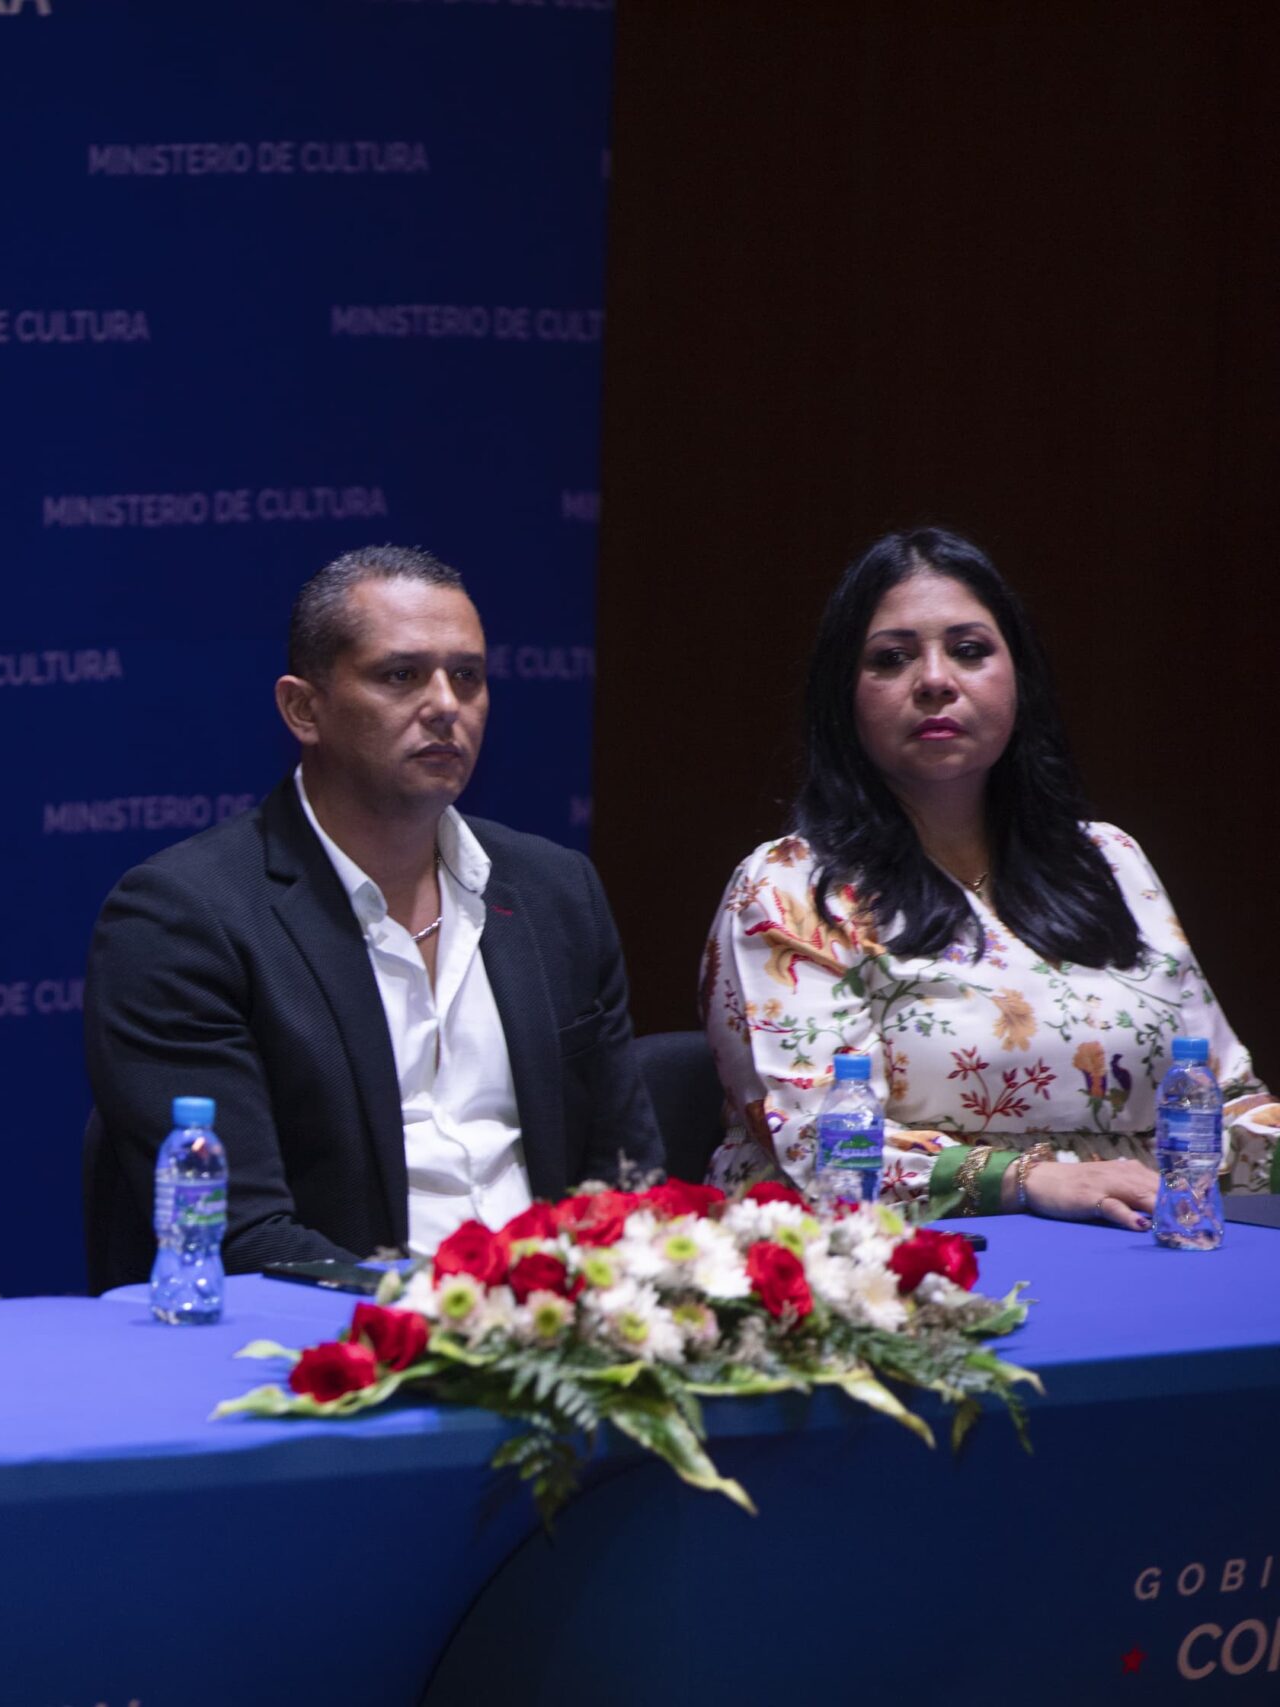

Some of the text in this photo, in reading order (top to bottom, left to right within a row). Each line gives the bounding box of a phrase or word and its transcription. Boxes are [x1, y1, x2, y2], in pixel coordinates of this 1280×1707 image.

[89, 141, 426, 175] MINISTERIO DE CULTURA
[17, 310, 147, 342] CULTURA
[331, 304, 489, 337] MINISTERIO
[493, 306, 529, 340] DE
[43, 487, 385, 526] MINISTERIO DE CULTURA
[42, 794, 212, 834] MINISTERIO
